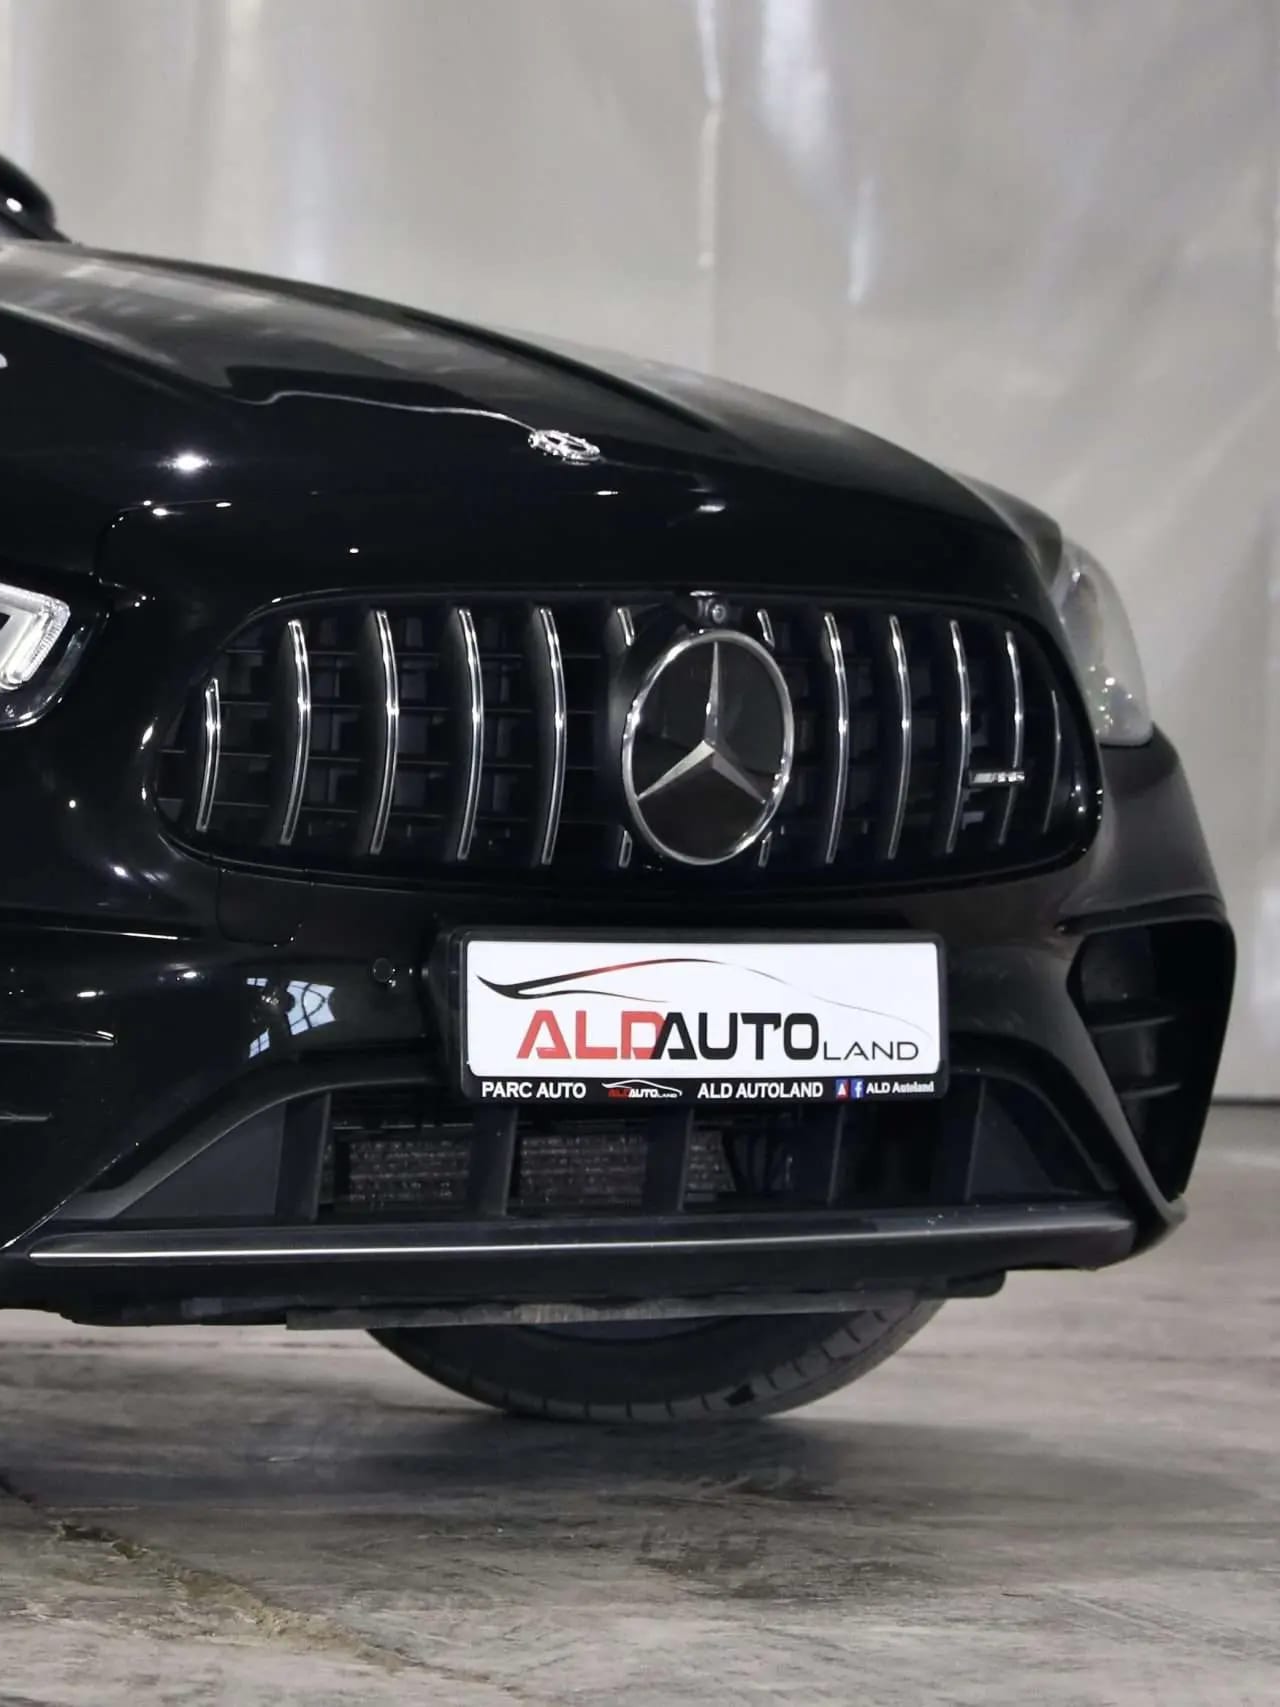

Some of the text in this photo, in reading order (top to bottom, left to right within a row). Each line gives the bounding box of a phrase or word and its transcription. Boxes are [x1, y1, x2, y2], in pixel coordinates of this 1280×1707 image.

[481, 1081, 587, 1099] PARC AUTO
[697, 1082, 824, 1099] ALD AUTOLAND
[866, 1082, 891, 1095] ALD
